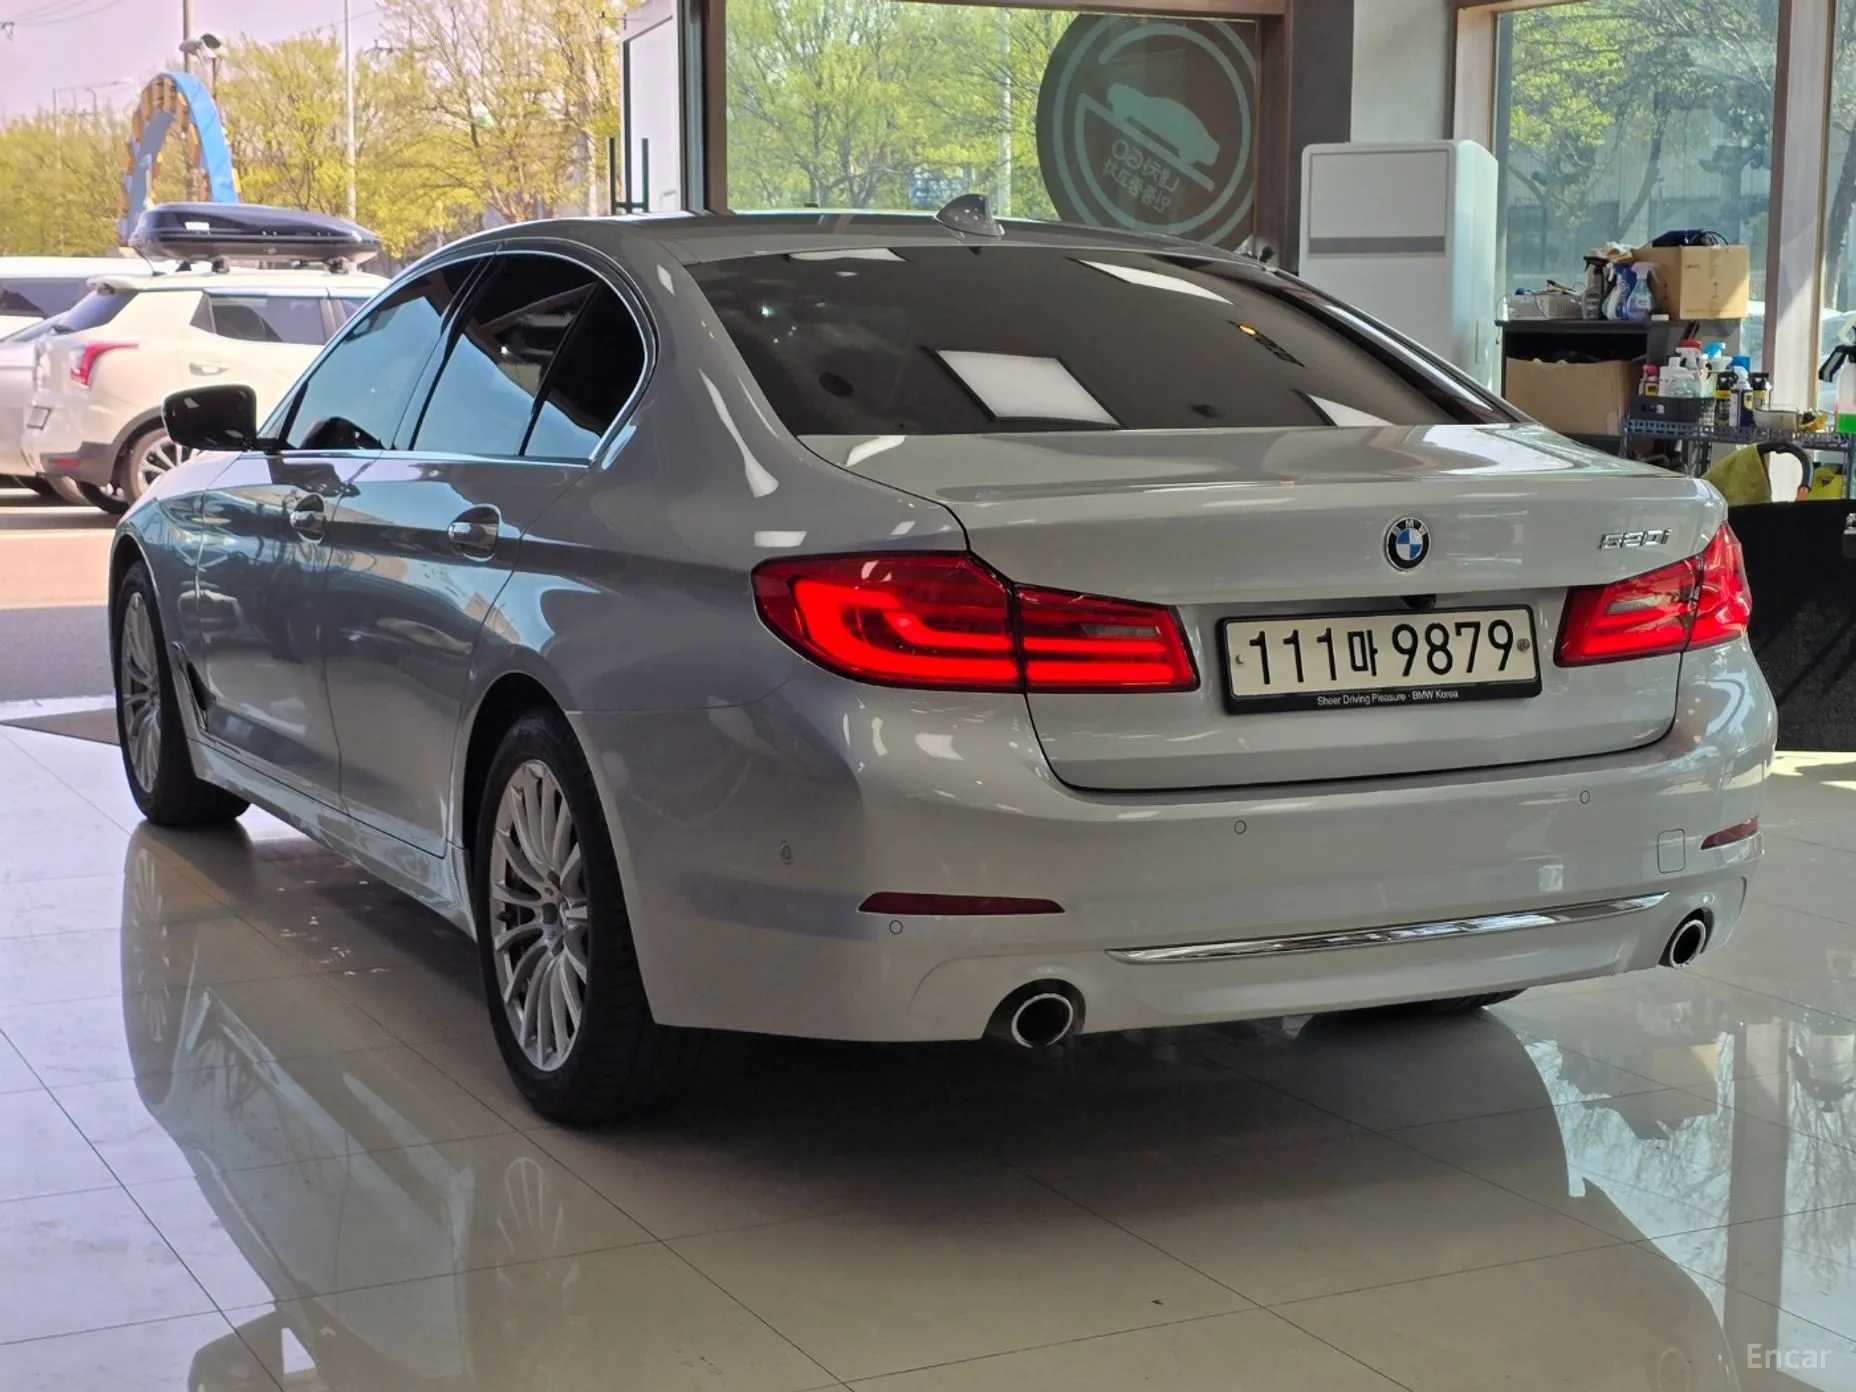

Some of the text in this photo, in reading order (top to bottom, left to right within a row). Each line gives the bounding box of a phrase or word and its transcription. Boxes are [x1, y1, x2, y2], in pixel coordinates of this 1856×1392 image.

[1317, 689, 1459, 706] Sheer Driving Pleasure BMW Korea
